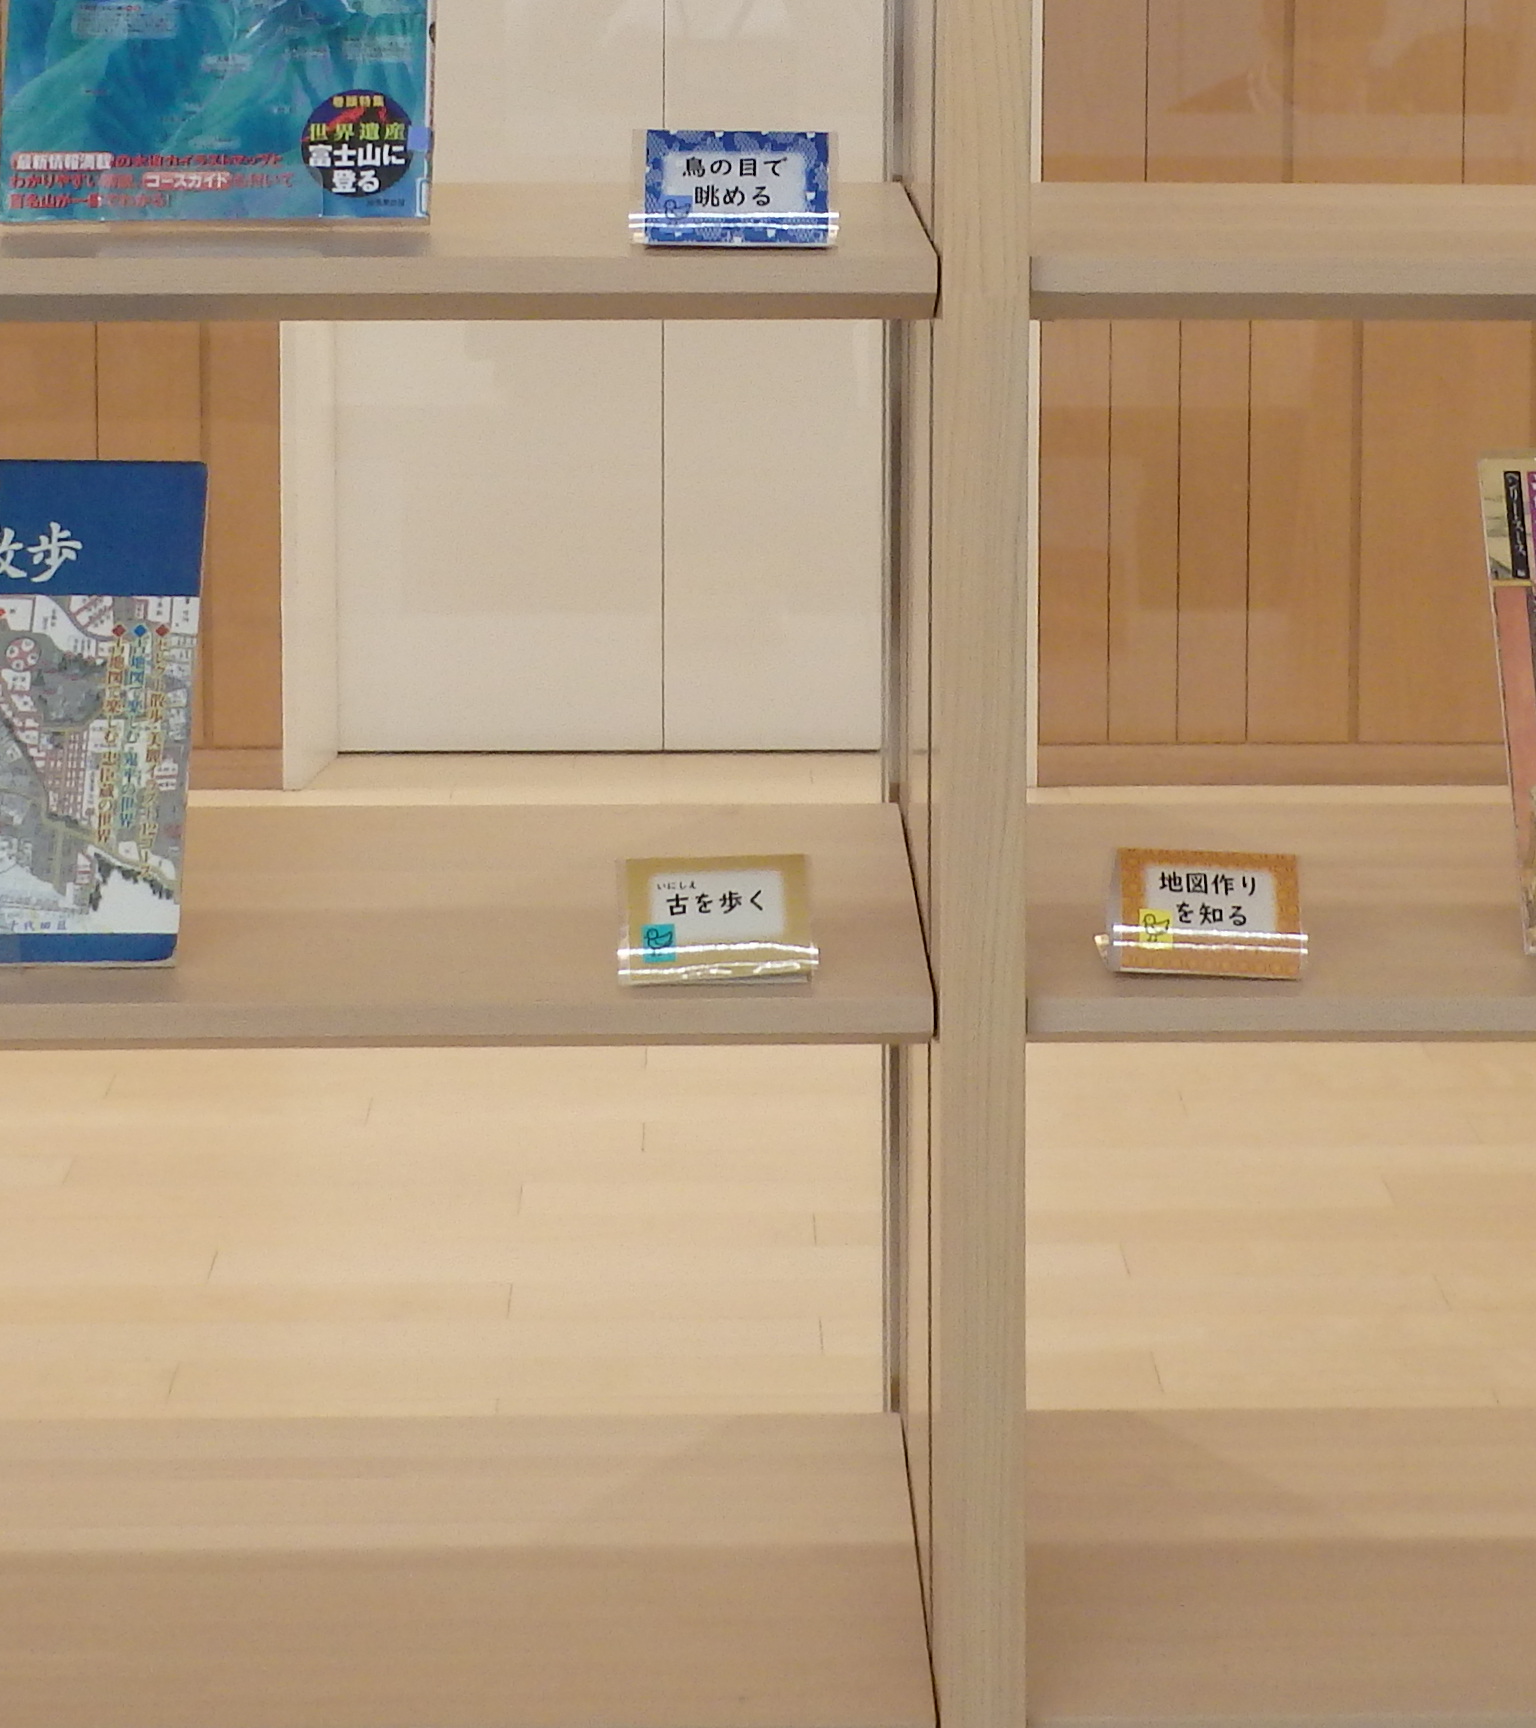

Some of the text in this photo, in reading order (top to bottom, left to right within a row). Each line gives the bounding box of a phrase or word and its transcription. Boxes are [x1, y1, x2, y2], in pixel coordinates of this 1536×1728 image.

[309, 122, 406, 142] 世界遺産
[309, 144, 406, 168] 富士山に
[682, 156, 788, 178] 鳥の目で
[332, 169, 381, 194] 登る
[694, 184, 771, 208] 眺める
[655, 879, 697, 891] いにしえ
[1157, 871, 1258, 897] 地図作り
[665, 888, 766, 917] 古を歩く
[1175, 901, 1248, 928] を知る
